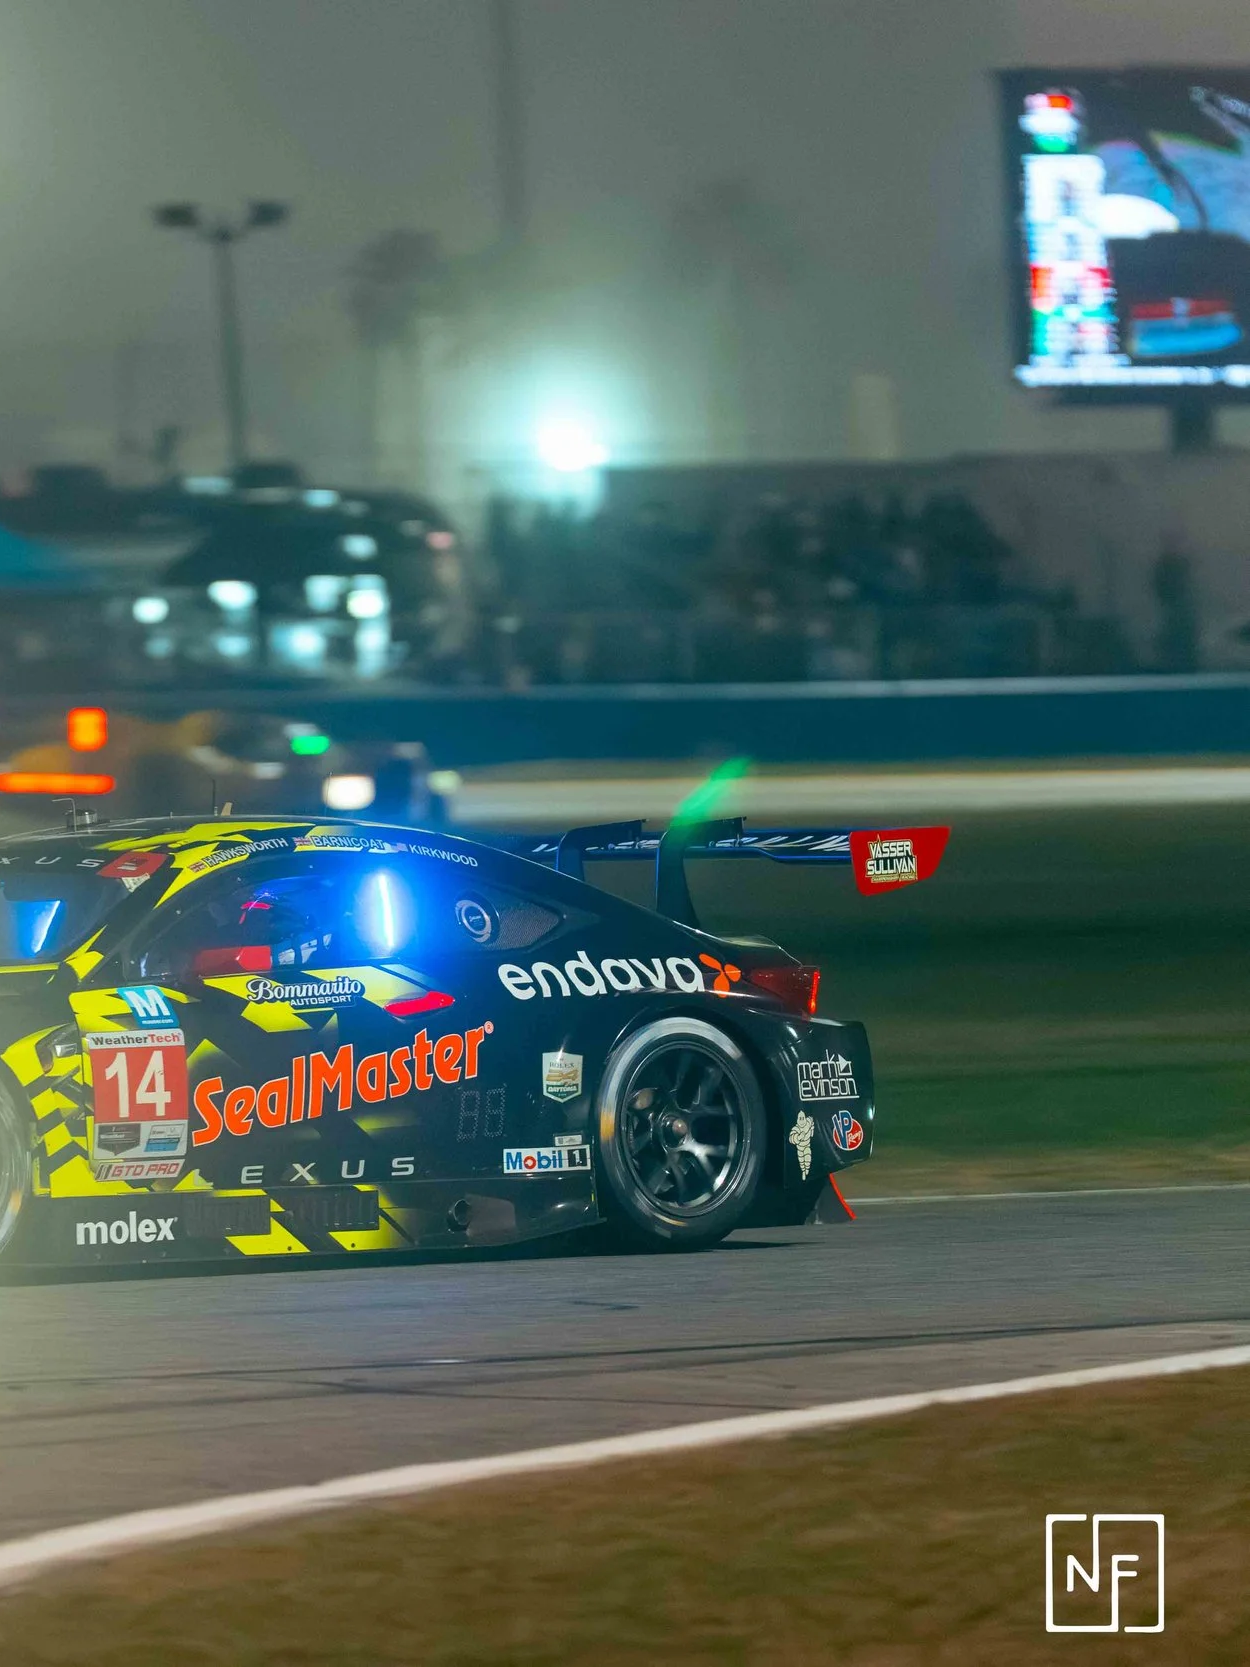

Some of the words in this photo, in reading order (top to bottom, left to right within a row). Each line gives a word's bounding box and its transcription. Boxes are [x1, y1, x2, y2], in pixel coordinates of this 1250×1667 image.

[203, 837, 289, 867] HAWKSWORTH
[312, 836, 386, 850] BARNICOAT
[408, 843, 479, 868] KIRKWOOD
[869, 840, 912, 859] VASSER
[866, 857, 916, 875] SULLIVAN
[246, 975, 362, 1001] Bommarito
[498, 951, 705, 1000] endava
[123, 988, 171, 1018] M
[290, 994, 353, 1006] AUTOSPORT
[91, 1032, 181, 1047] WeatherTech
[105, 1049, 172, 1118] 14
[191, 1026, 485, 1147] SealMaster
[146, 1162, 181, 1177] PRO
[194, 1156, 415, 1188] LEXUS
[505, 1150, 564, 1170] Mobil
[571, 1149, 584, 1165] 1
[76, 1211, 176, 1246] molex
